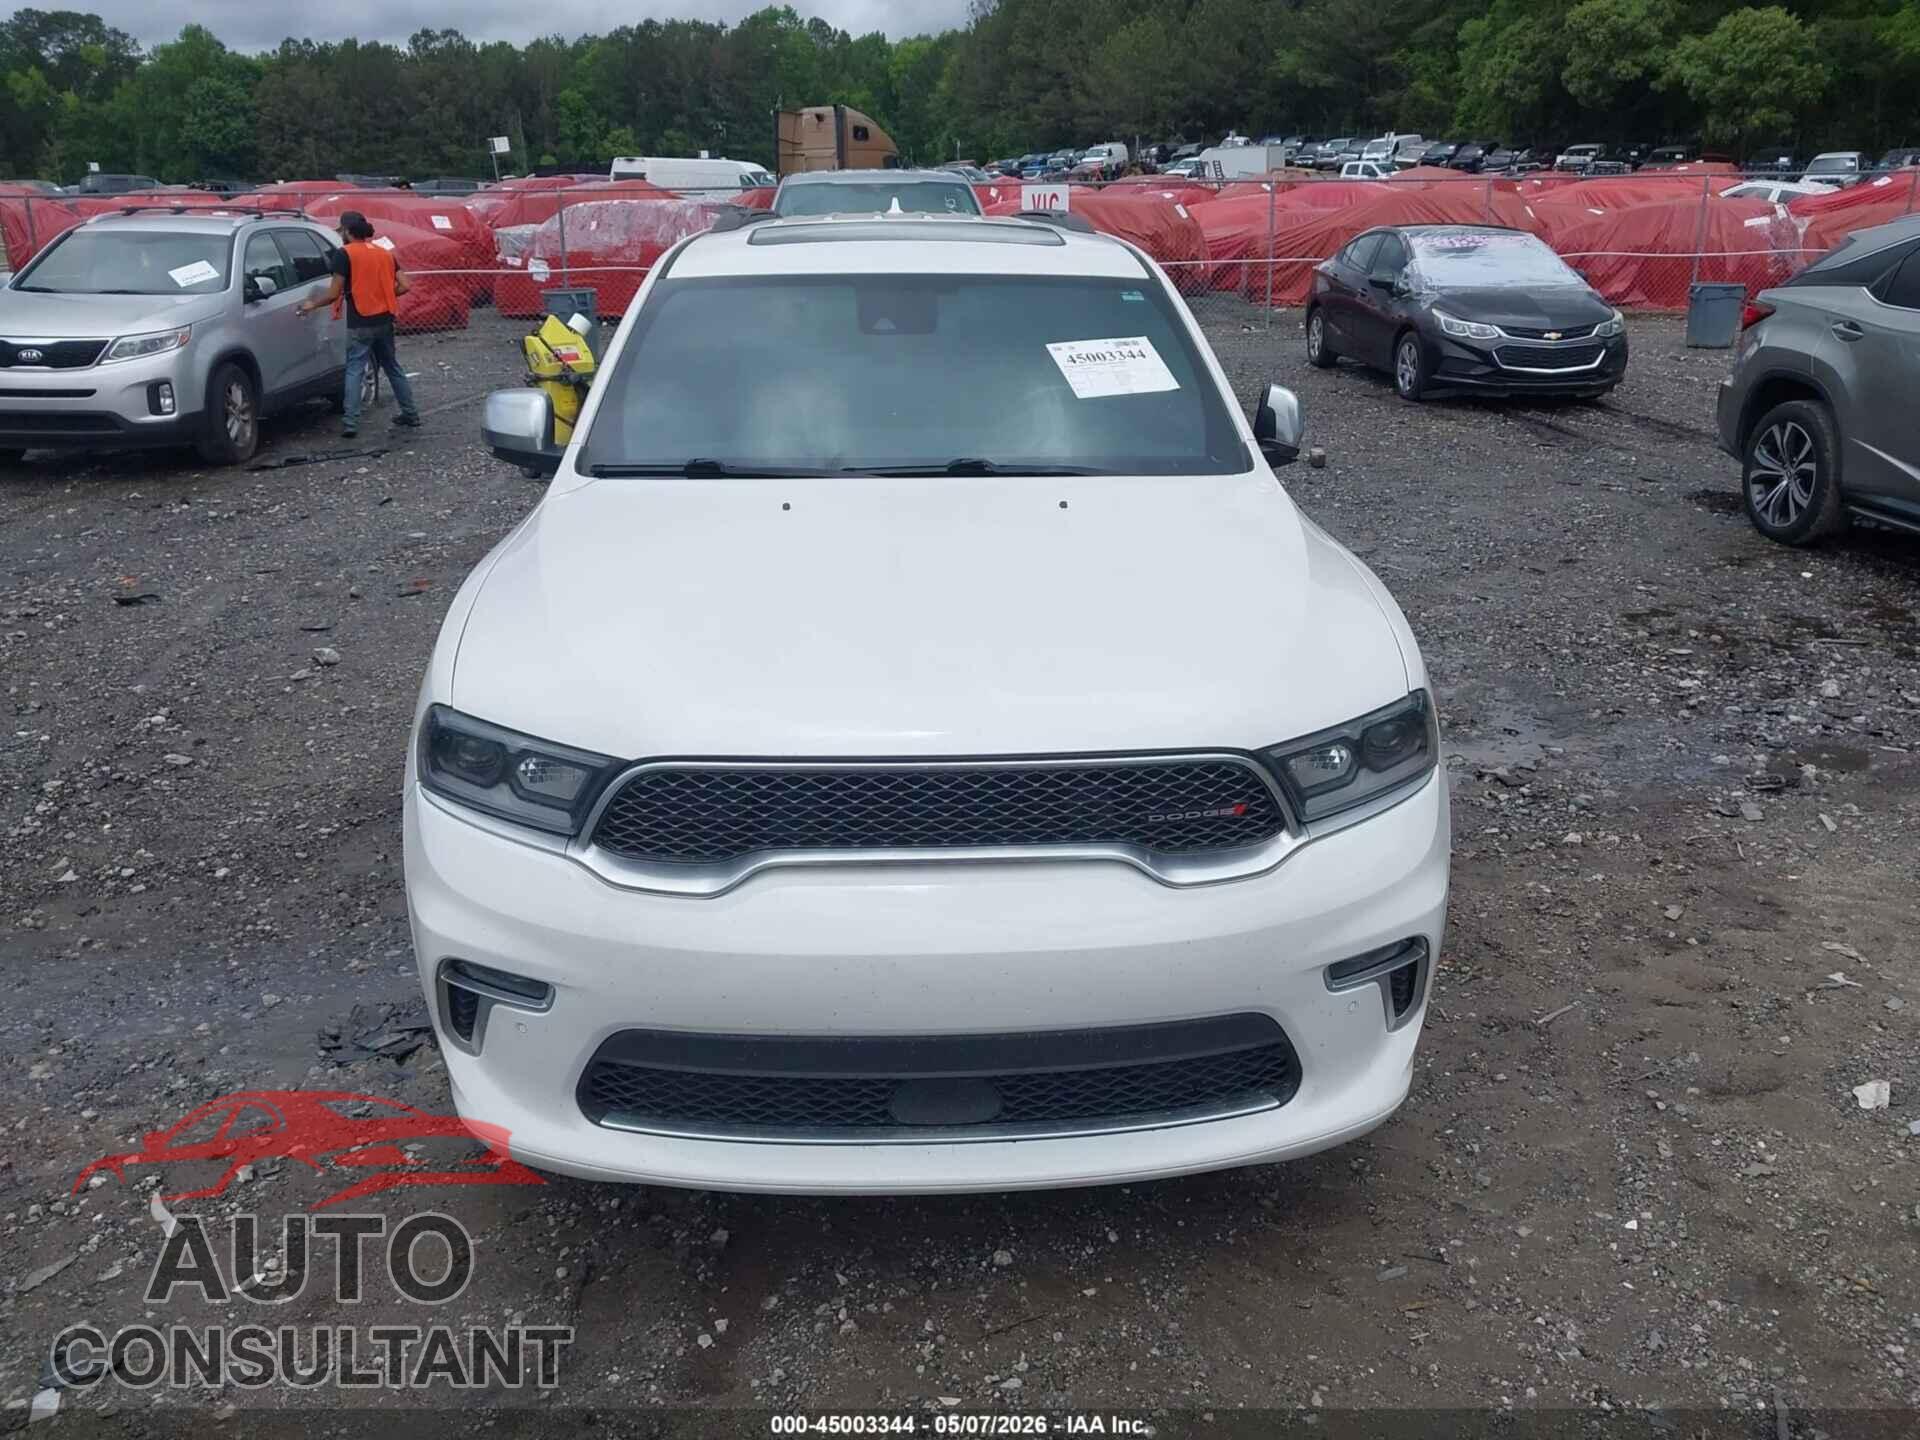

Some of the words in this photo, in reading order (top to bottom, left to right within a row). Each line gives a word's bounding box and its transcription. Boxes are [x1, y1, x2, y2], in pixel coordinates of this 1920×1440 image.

[20, 350, 42, 361] KIA
[1067, 349, 1146, 364] 45003344
[1148, 808, 1235, 822] DODGE
